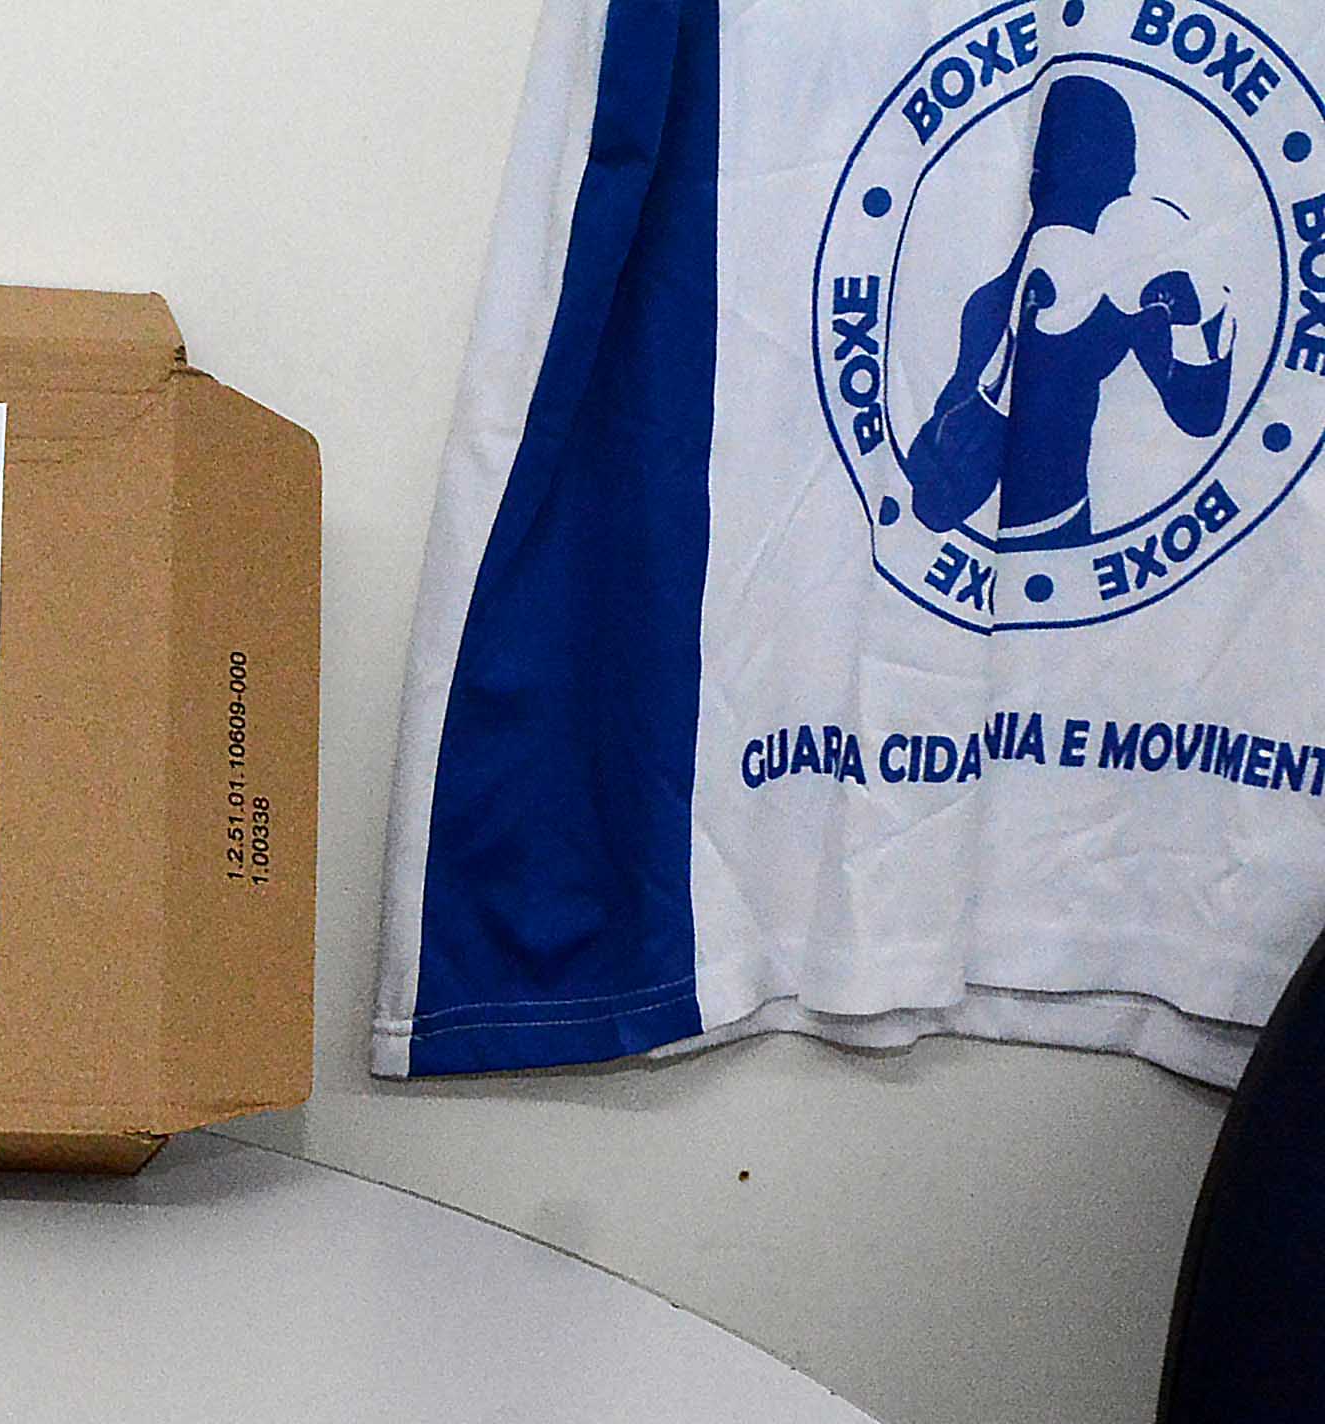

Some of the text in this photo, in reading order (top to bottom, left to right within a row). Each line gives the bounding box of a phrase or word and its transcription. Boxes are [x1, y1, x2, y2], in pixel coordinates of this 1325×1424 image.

[902, 13, 1038, 146] BOXE
[1130, 0, 1282, 117] BOXE
[833, 275, 885, 455] BOXE
[1093, 478, 1241, 601] BOXE
[741, 725, 866, 789] GUARA
[879, 711, 1045, 784] CIDANIA
[1059, 718, 1090, 767] E
[252, 796, 270, 885] 1.00338
